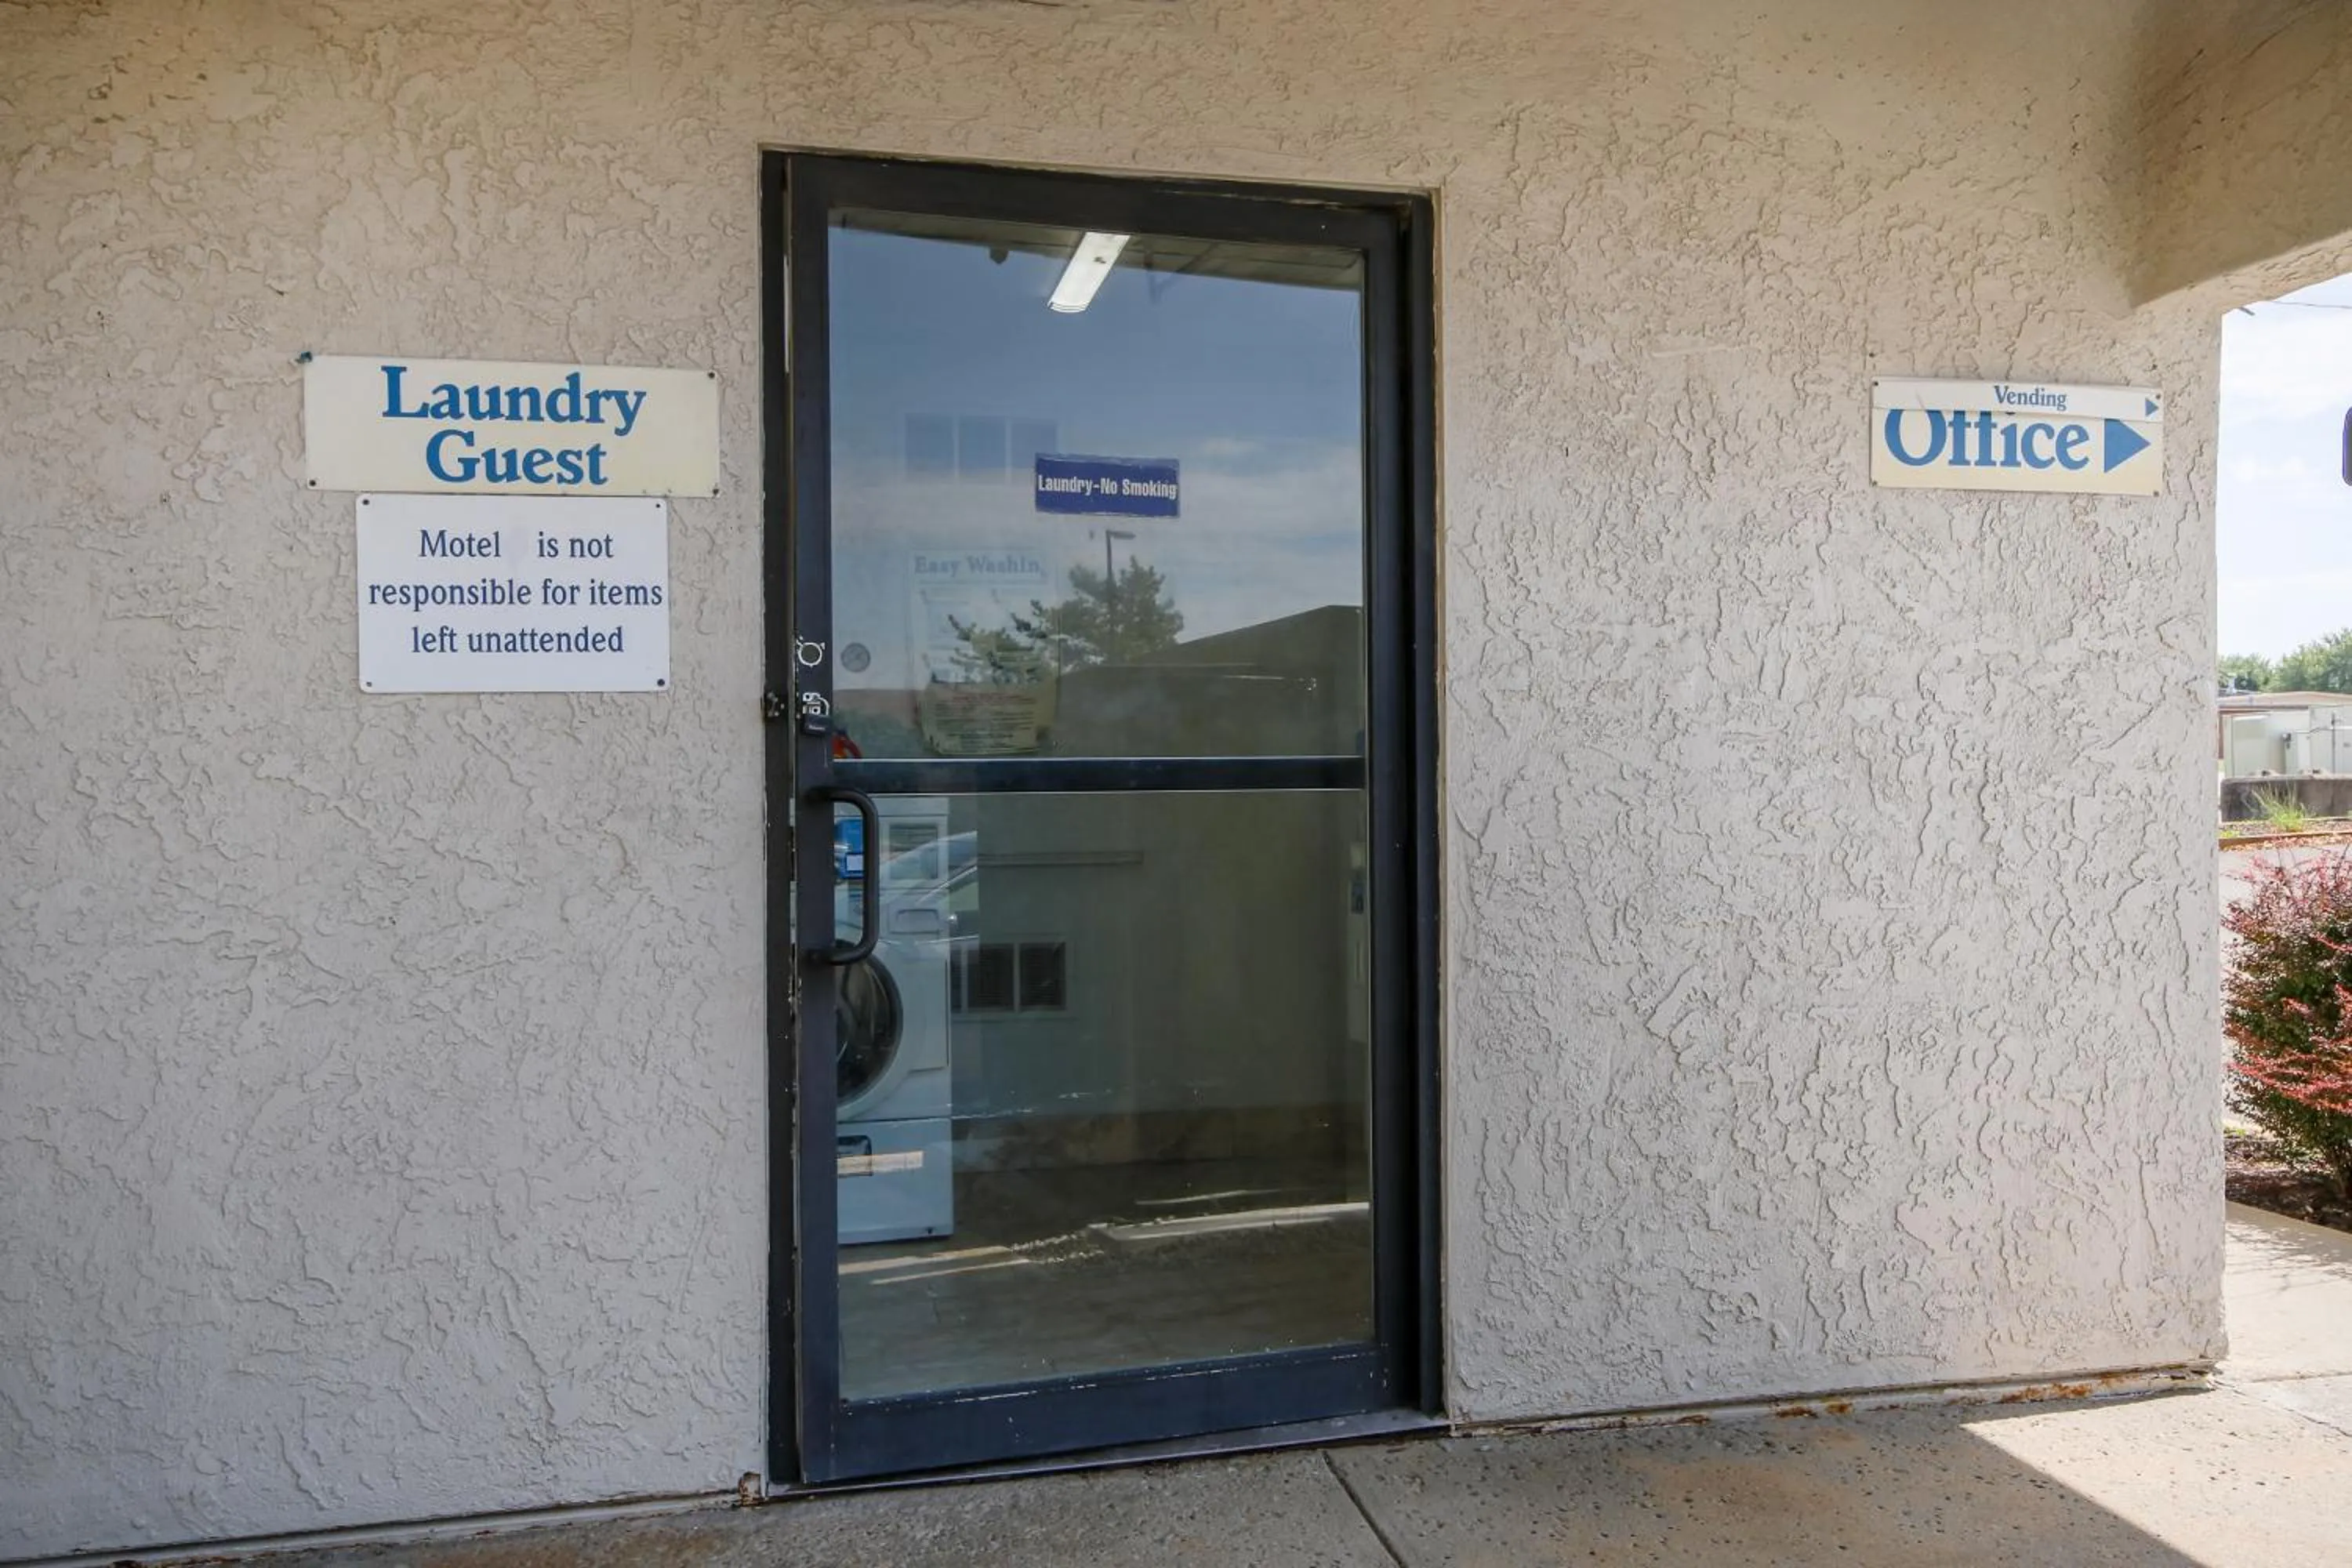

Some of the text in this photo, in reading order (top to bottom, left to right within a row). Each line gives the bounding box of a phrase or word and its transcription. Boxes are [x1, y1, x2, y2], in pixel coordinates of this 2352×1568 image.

[381, 365, 648, 437] Laundry
[1994, 385, 2067, 411] Vending
[425, 429, 608, 485] Guest
[1038, 474, 1178, 500] Laundry-No Smoking
[419, 529, 615, 558] Motel is not
[915, 555, 960, 578] Easy
[368, 577, 664, 612] responsible for items
[411, 625, 625, 653] left unattended
